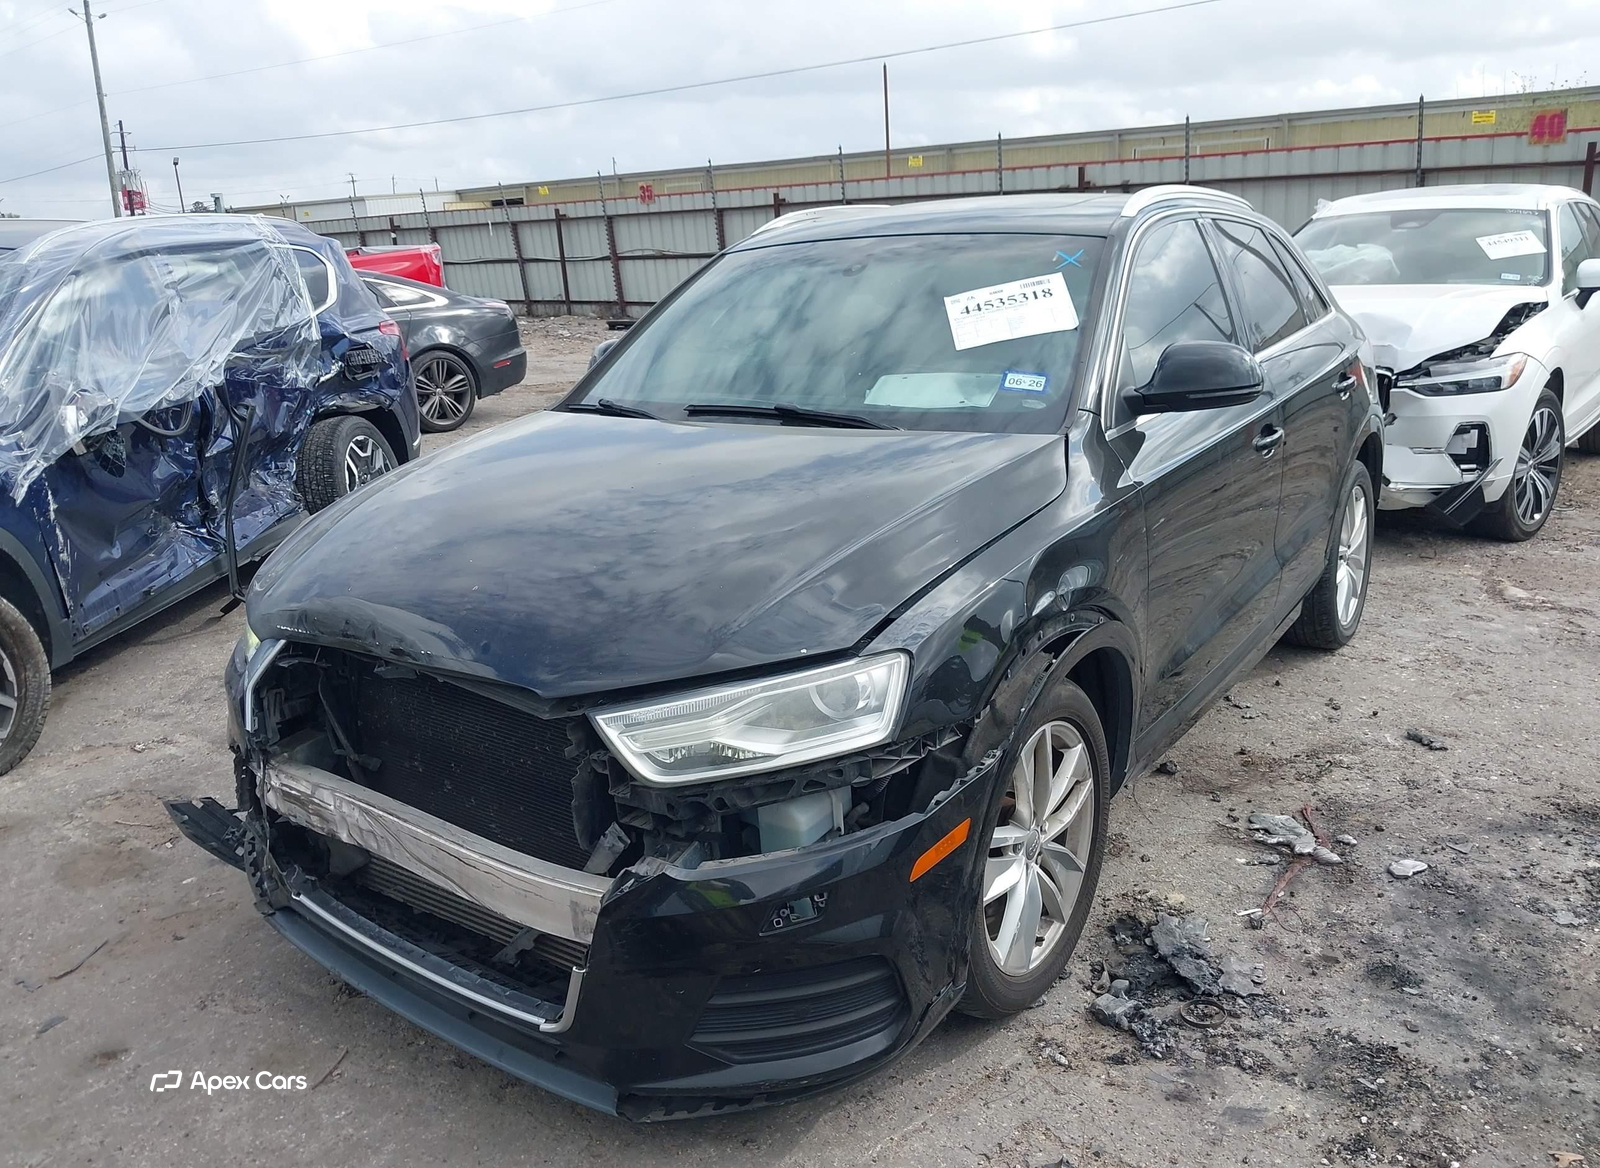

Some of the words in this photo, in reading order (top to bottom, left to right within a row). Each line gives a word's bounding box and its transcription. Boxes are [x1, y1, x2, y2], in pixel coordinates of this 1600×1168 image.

[1530, 112, 1566, 140] 40
[639, 184, 654, 202] 35
[960, 287, 1054, 316] 44535318
